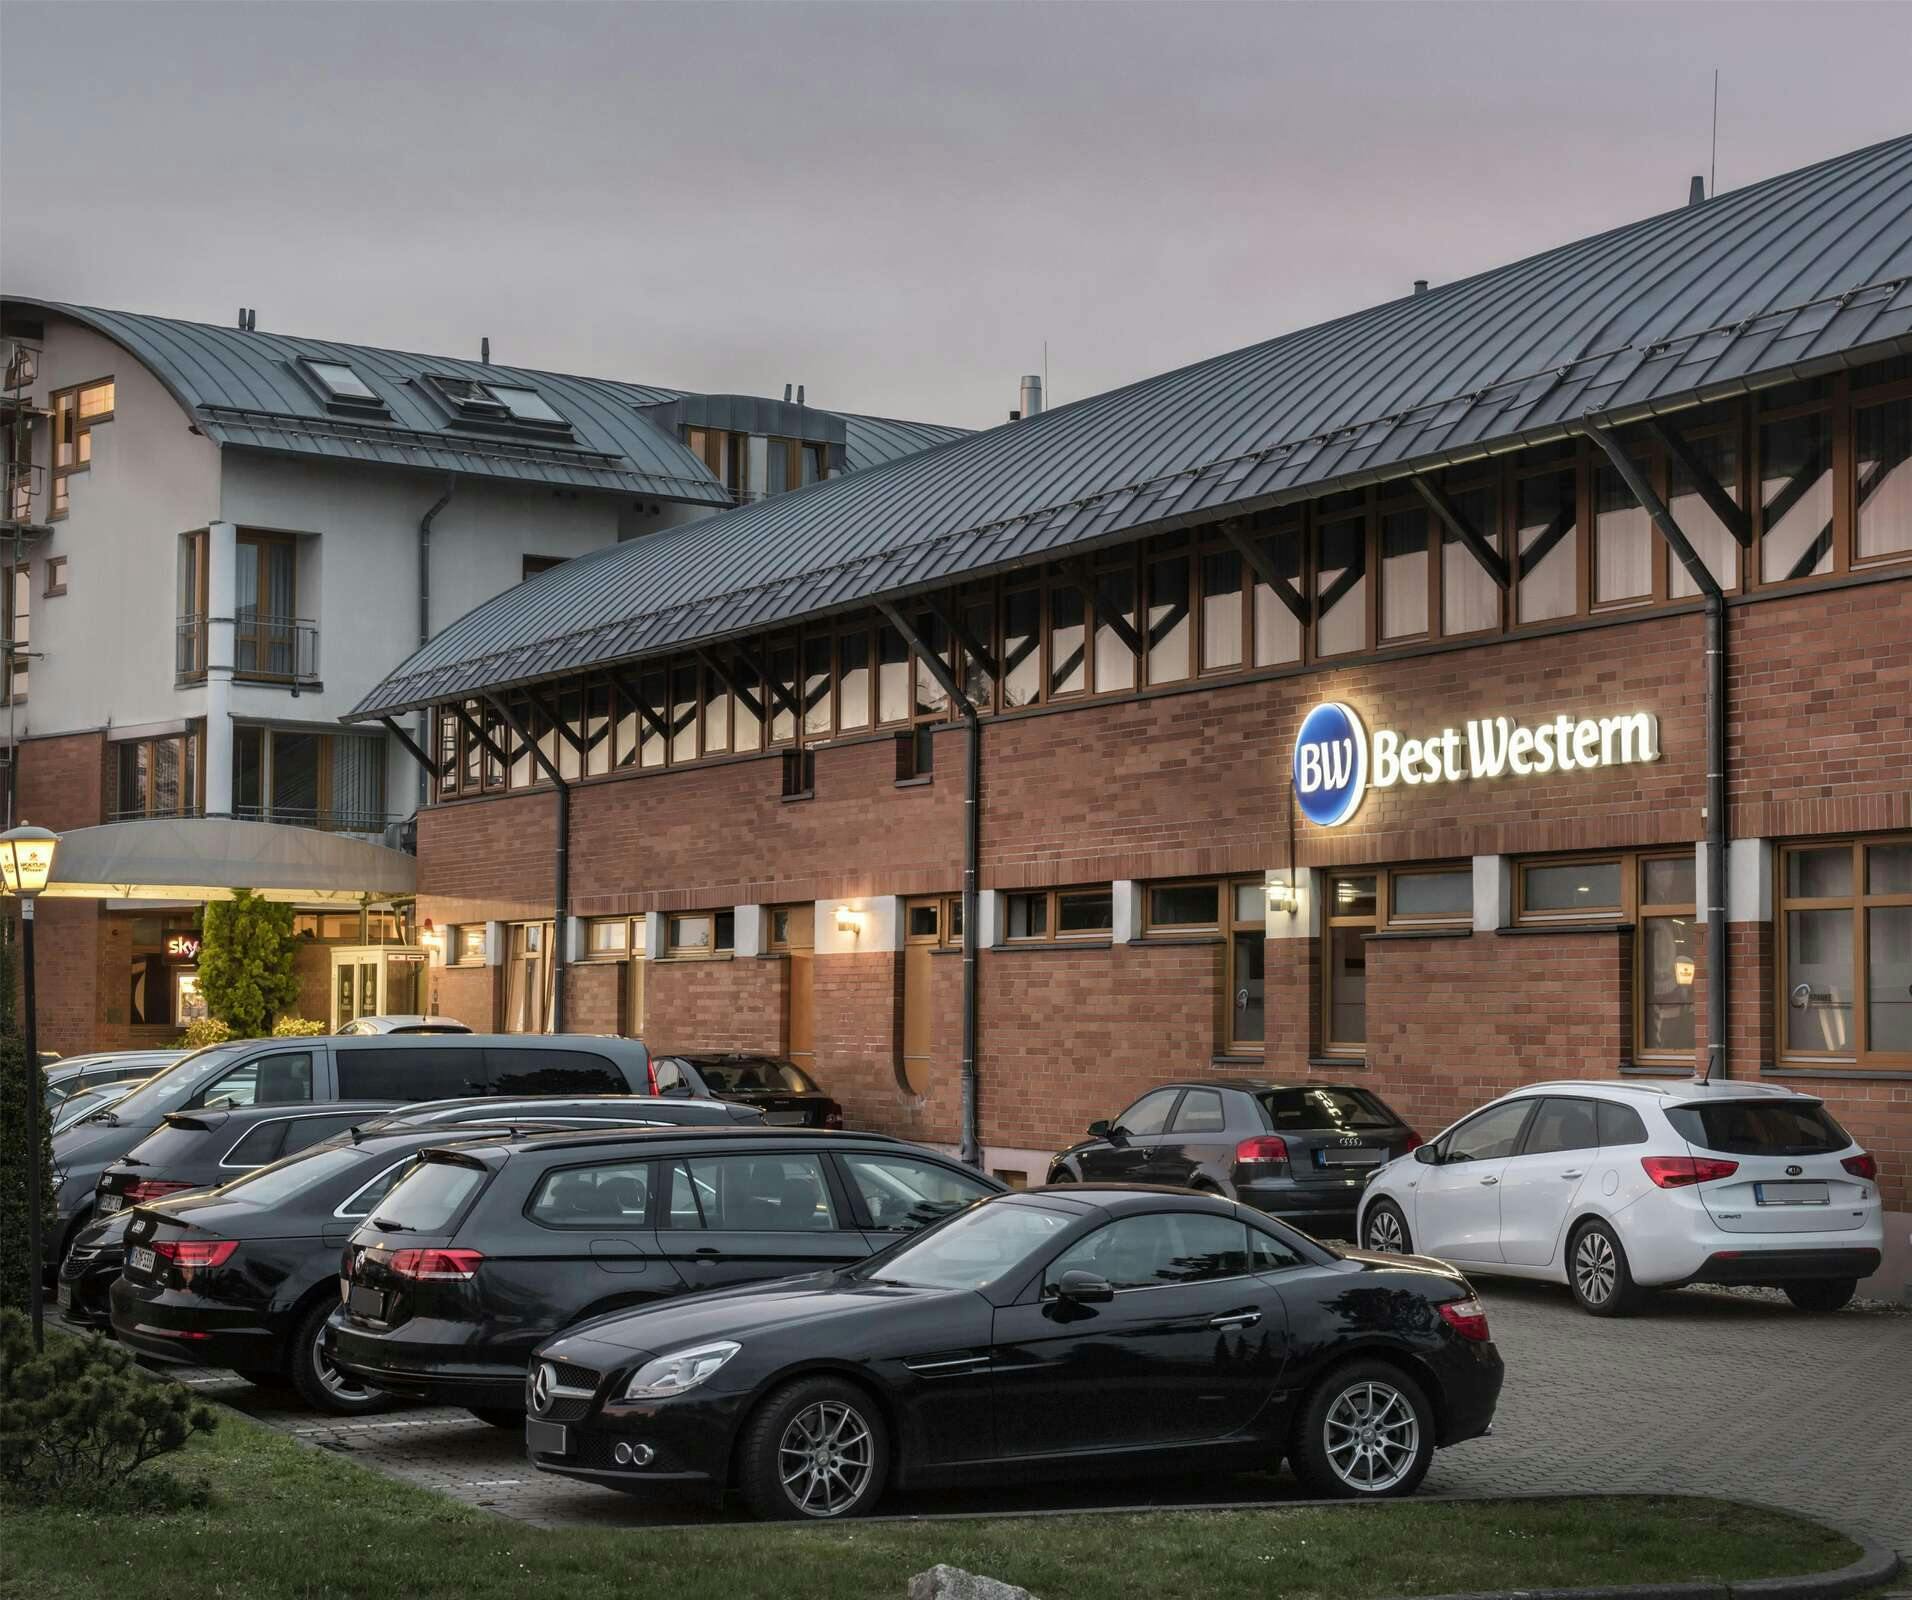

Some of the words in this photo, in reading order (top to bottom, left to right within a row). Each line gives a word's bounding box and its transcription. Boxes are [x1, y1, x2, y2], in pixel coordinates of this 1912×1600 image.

[1299, 738, 1353, 794] BW
[1372, 729, 1466, 788] Best
[1466, 712, 1659, 779] Western
[168, 936, 199, 958] sky
